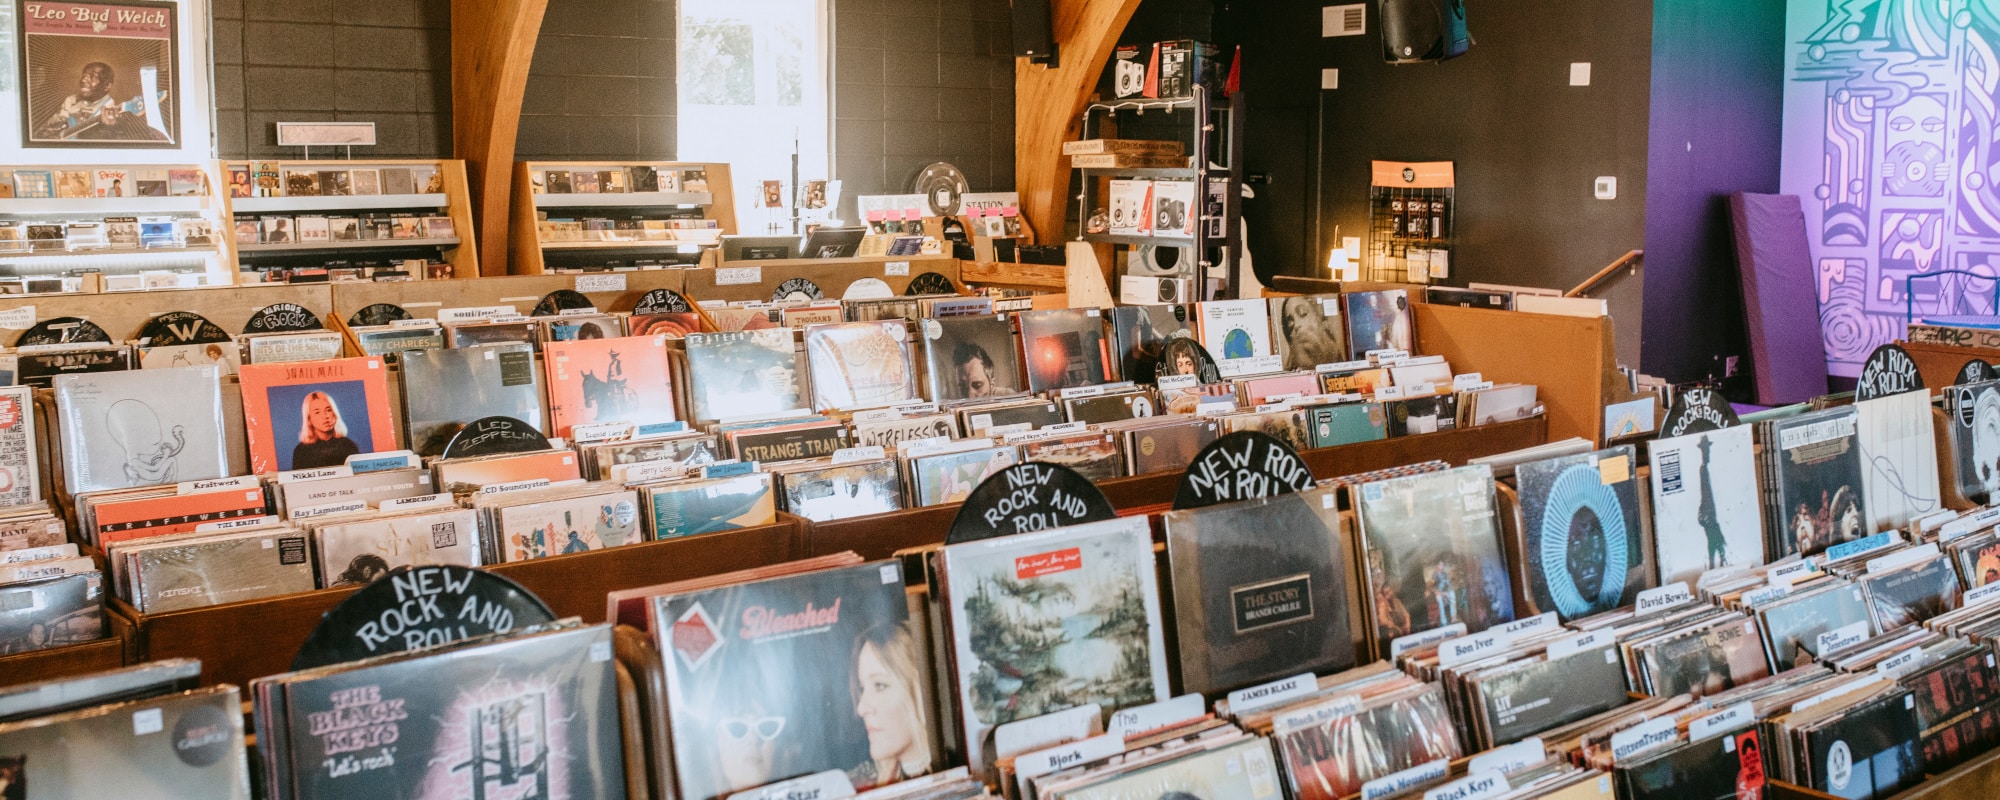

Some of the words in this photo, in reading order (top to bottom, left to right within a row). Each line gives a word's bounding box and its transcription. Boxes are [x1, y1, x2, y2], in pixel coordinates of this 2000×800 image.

[27, 4, 66, 20] Leo
[71, 7, 109, 22] Bud
[116, 10, 167, 28] Welch
[263, 303, 302, 315] VARIOUS
[646, 290, 679, 307] NEW
[263, 313, 306, 329] ROCK
[795, 315, 832, 324] THOUSAND
[167, 319, 204, 343] W
[387, 338, 430, 349] CHARLES
[286, 366, 314, 381] SNAIL
[318, 365, 345, 377] MAIL
[1861, 351, 1884, 396] NEW
[1888, 348, 1917, 386] ROCK
[1878, 372, 1909, 396] ROLL
[1683, 389, 1711, 409] NEW
[478, 420, 513, 433] LED
[1672, 405, 1703, 437] ROCK
[458, 430, 538, 452] ZEPPELIN
[866, 425, 931, 448] WIRELESS
[745, 442, 802, 462] STRANGE
[806, 436, 849, 454] TRAILS
[292, 471, 315, 480] Nikki
[318, 469, 337, 478] Lane
[640, 467, 658, 476] Jerry
[660, 465, 673, 473] Lee
[1005, 464, 1055, 491] NEW
[1189, 438, 1253, 498] NEW
[1264, 443, 1318, 493] ROCK
[193, 479, 241, 490] Kraftwerk
[339, 489, 355, 497] TALK
[499, 480, 551, 493] Soundsystem
[1236, 468, 1279, 505] ROLL
[294, 508, 312, 518] Ray
[313, 502, 365, 516] Lamontagne
[396, 496, 438, 505] LAMBCHOP
[984, 486, 1040, 529] ROCK
[1050, 488, 1088, 519] AND
[106, 507, 262, 532] KRAFTWERK
[1013, 512, 1061, 534] ROLL
[1, 528, 28, 538] BAND
[158, 585, 201, 600] KINSKI
[392, 567, 475, 603] NEW
[1245, 594, 1265, 609] THE
[1266, 586, 1300, 605] STORY
[1640, 596, 1664, 609] David
[1665, 590, 1689, 604] Bowie
[356, 594, 444, 651] ROCK
[457, 594, 513, 635] AND
[740, 597, 842, 639] Bleached
[403, 625, 470, 652] ROLL
[1718, 626, 1742, 642] BOWIE
[1455, 641, 1474, 657] Bon
[1475, 636, 1494, 651] Iver
[330, 684, 382, 706] THE
[1241, 688, 1269, 702] JAMES
[1270, 680, 1298, 695] BLAKE
[307, 698, 408, 735] BLACK
[1117, 714, 1138, 728] The
[1287, 711, 1315, 729] Black
[324, 723, 399, 756] KEYS
[1048, 750, 1083, 768] Bjork
[1367, 784, 1396, 800] Black
[1396, 768, 1446, 789] Mountain
[1468, 775, 1495, 797] Keys
